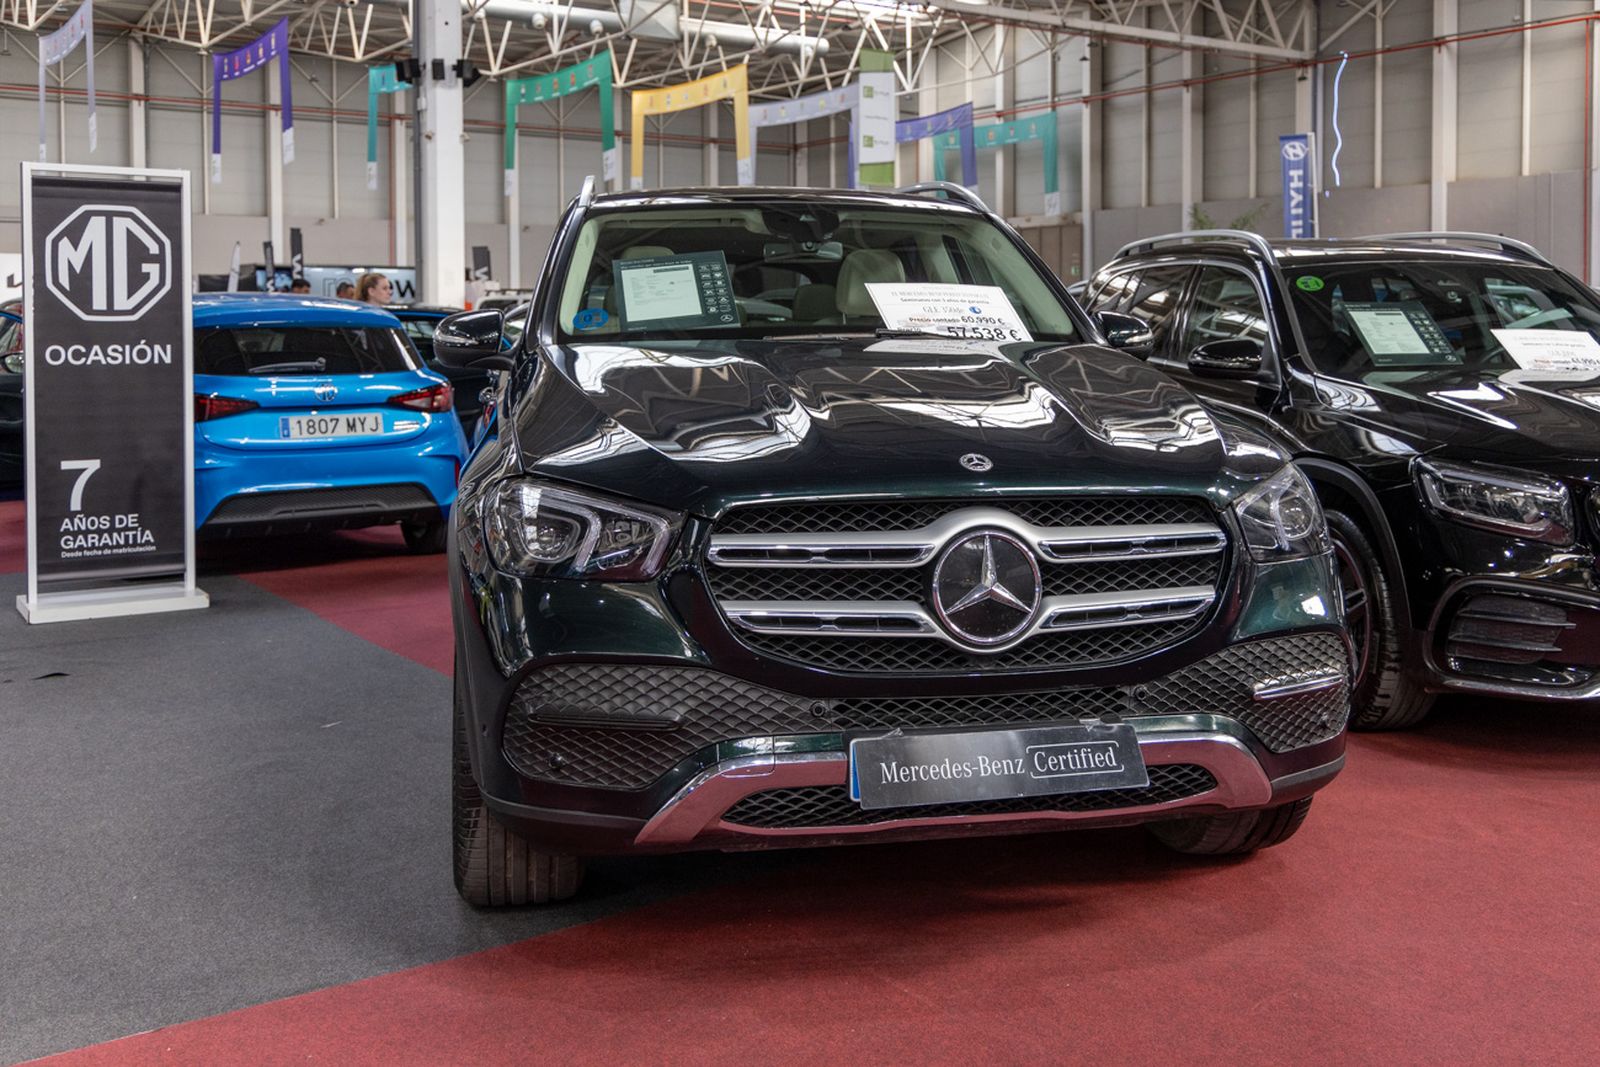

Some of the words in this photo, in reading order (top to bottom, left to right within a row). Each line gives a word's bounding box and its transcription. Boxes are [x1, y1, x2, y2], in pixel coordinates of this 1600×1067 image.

[57, 215, 161, 312] MG
[961, 315, 997, 325] 60.990
[45, 340, 172, 366] OCASIÓN
[296, 417, 340, 436] 1807
[346, 415, 380, 433] MYJ
[60, 458, 101, 512] 7
[60, 514, 111, 532] AÑOS
[114, 513, 140, 529] DE
[60, 527, 155, 549] GARANTÍA
[61, 550, 83, 558] Desde
[83, 548, 102, 557] fecha
[102, 547, 112, 555] de
[112, 545, 157, 554] matriculación
[879, 754, 1026, 785] Mercedes-Benz
[1033, 746, 1118, 774] Certified
